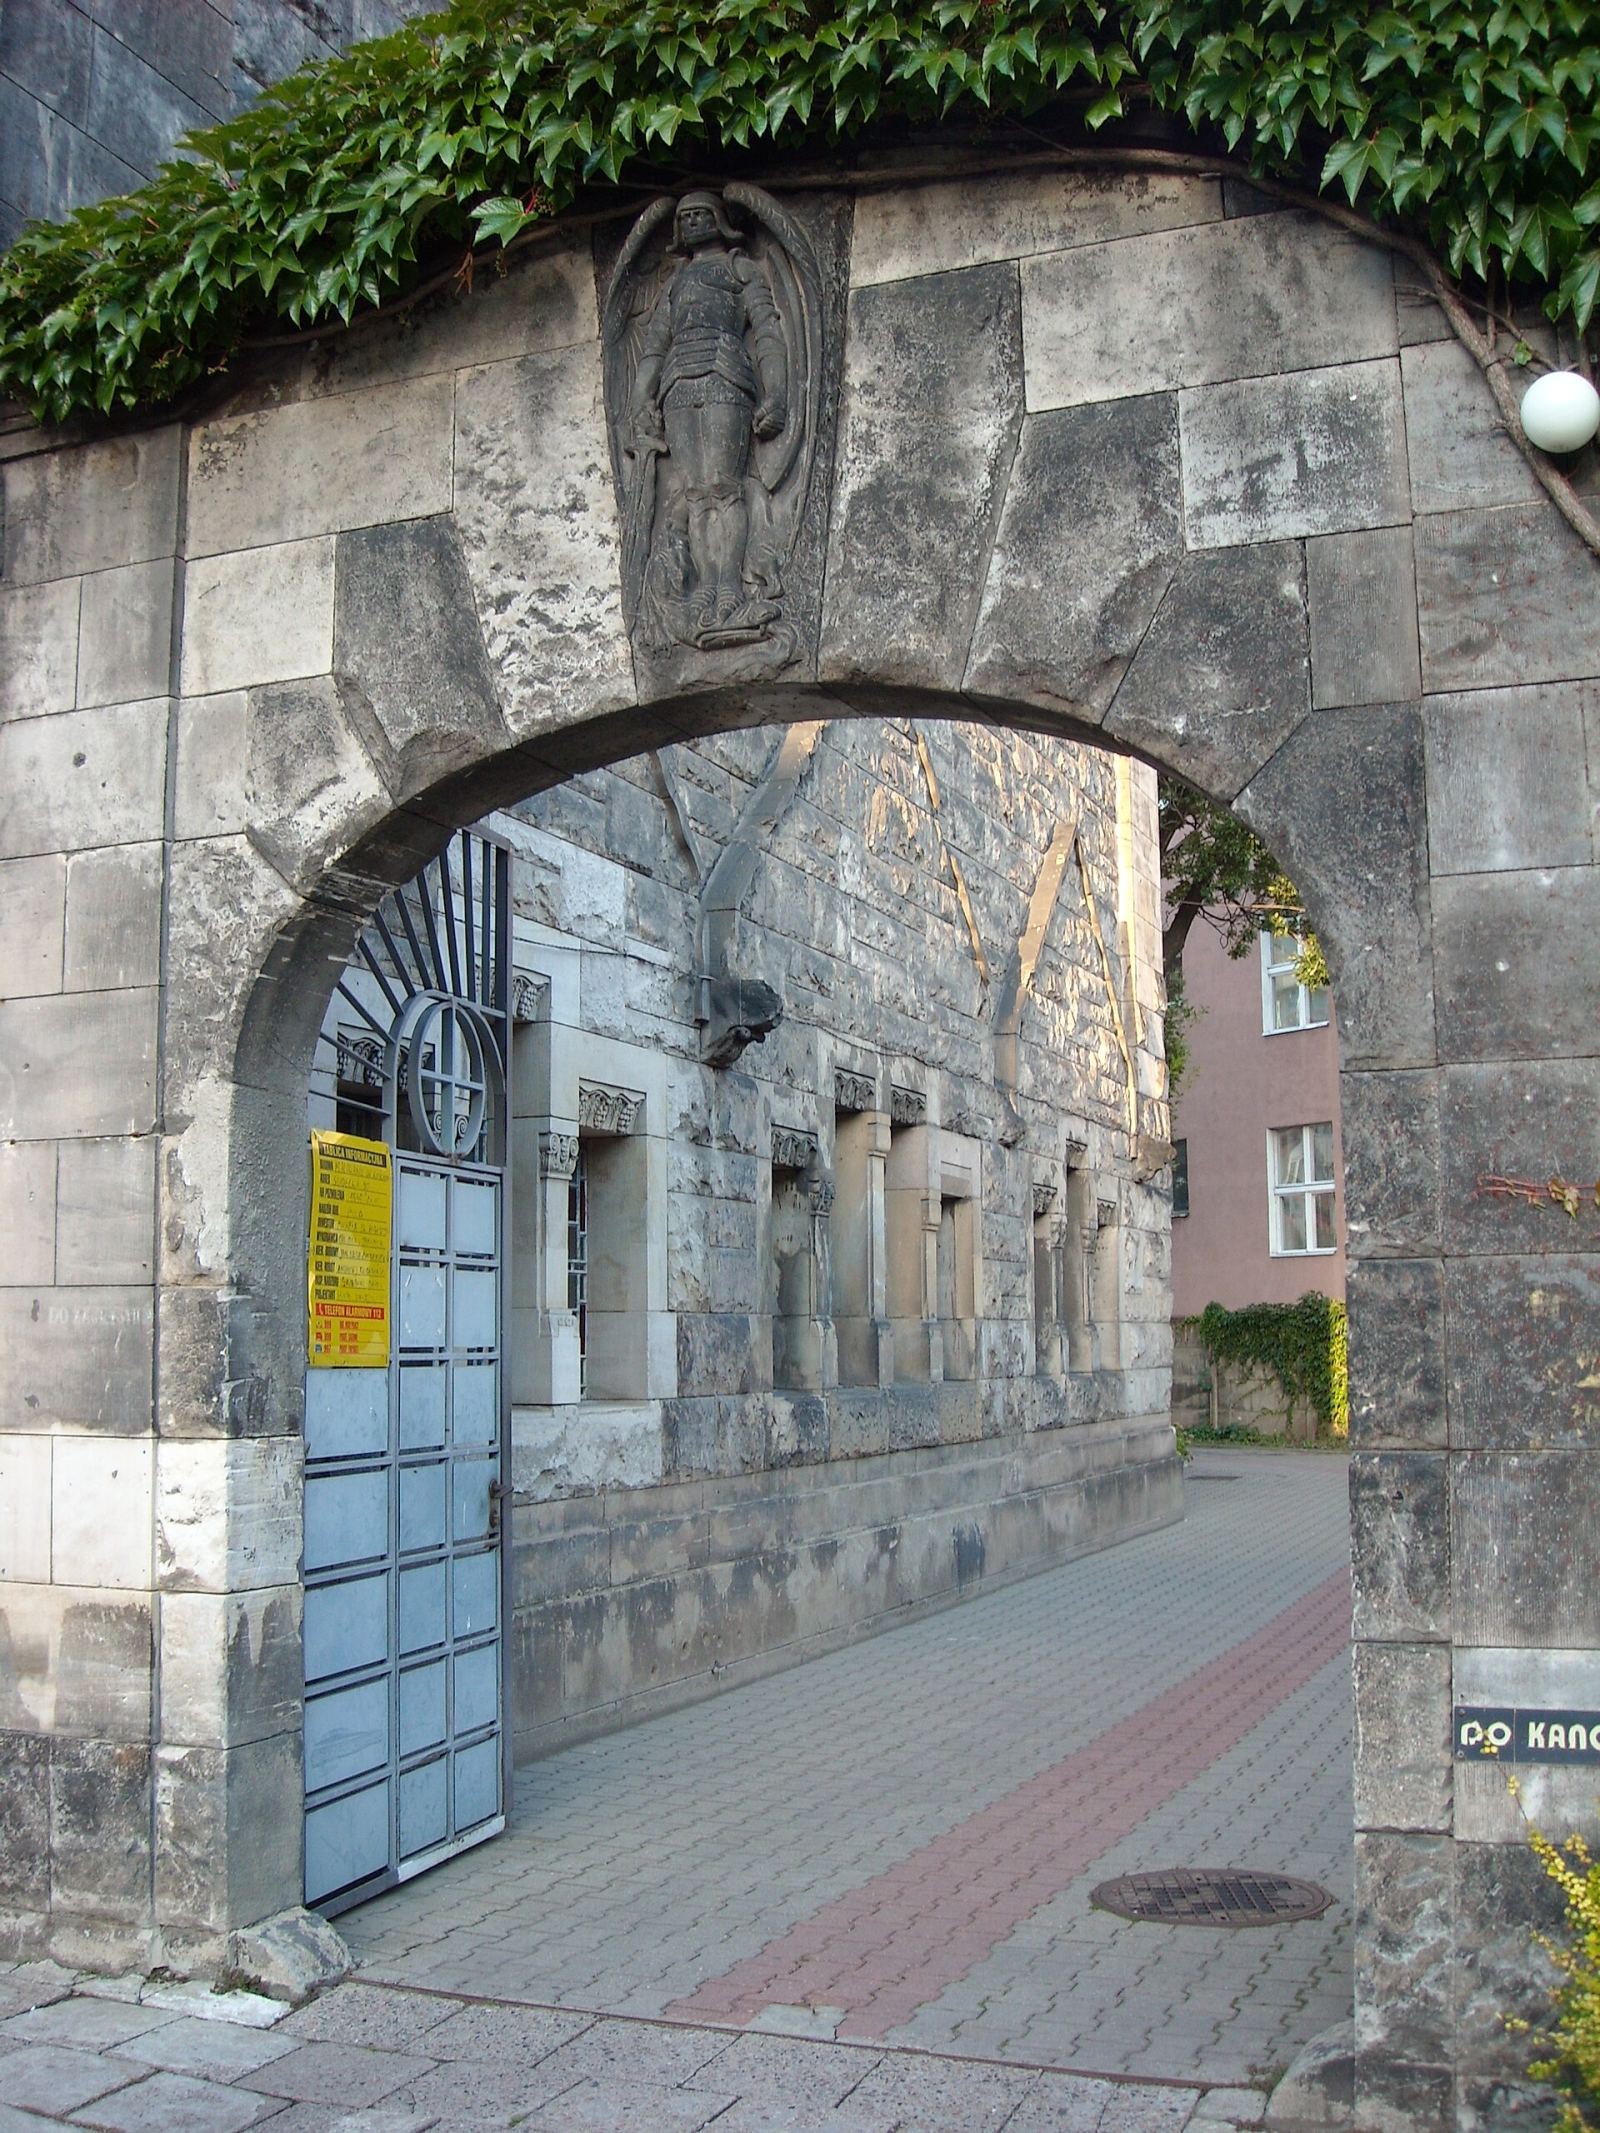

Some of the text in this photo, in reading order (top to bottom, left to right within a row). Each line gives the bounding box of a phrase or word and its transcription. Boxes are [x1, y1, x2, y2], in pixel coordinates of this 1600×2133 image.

[323, 1144, 383, 1165] TABLICA INFORMACYJNA
[324, 1304, 345, 1316] TELEFON
